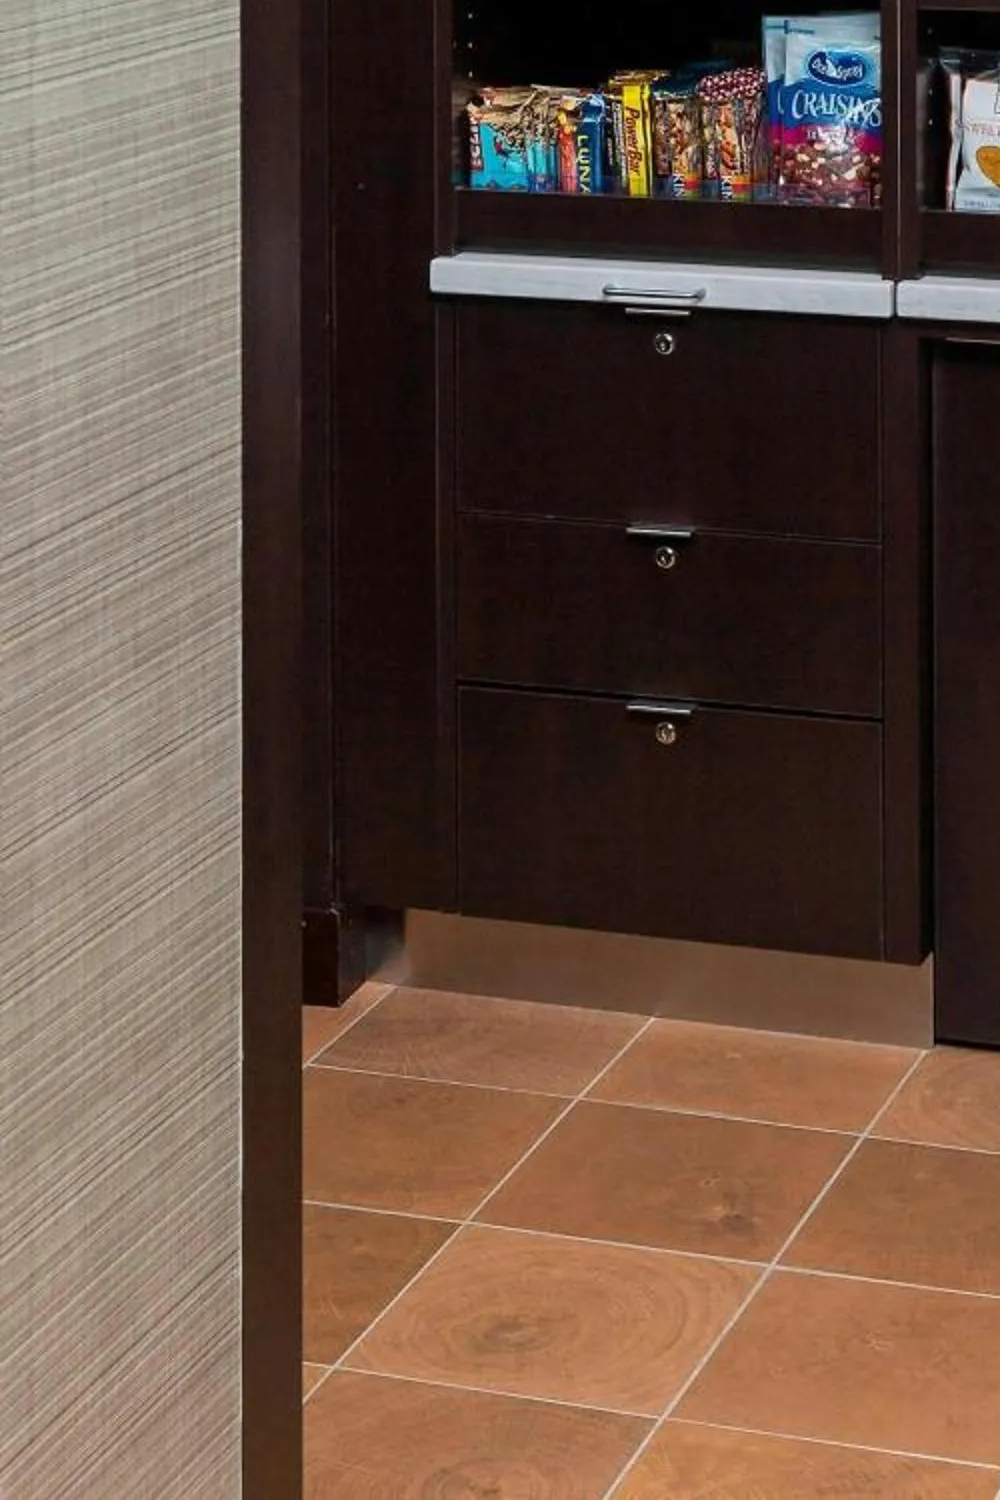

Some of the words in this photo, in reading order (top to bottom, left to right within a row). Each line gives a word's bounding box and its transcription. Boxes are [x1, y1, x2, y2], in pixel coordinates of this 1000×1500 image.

[626, 106, 643, 176] PowerBar
[673, 173, 686, 197] KIN
[721, 175, 734, 199] KIN
